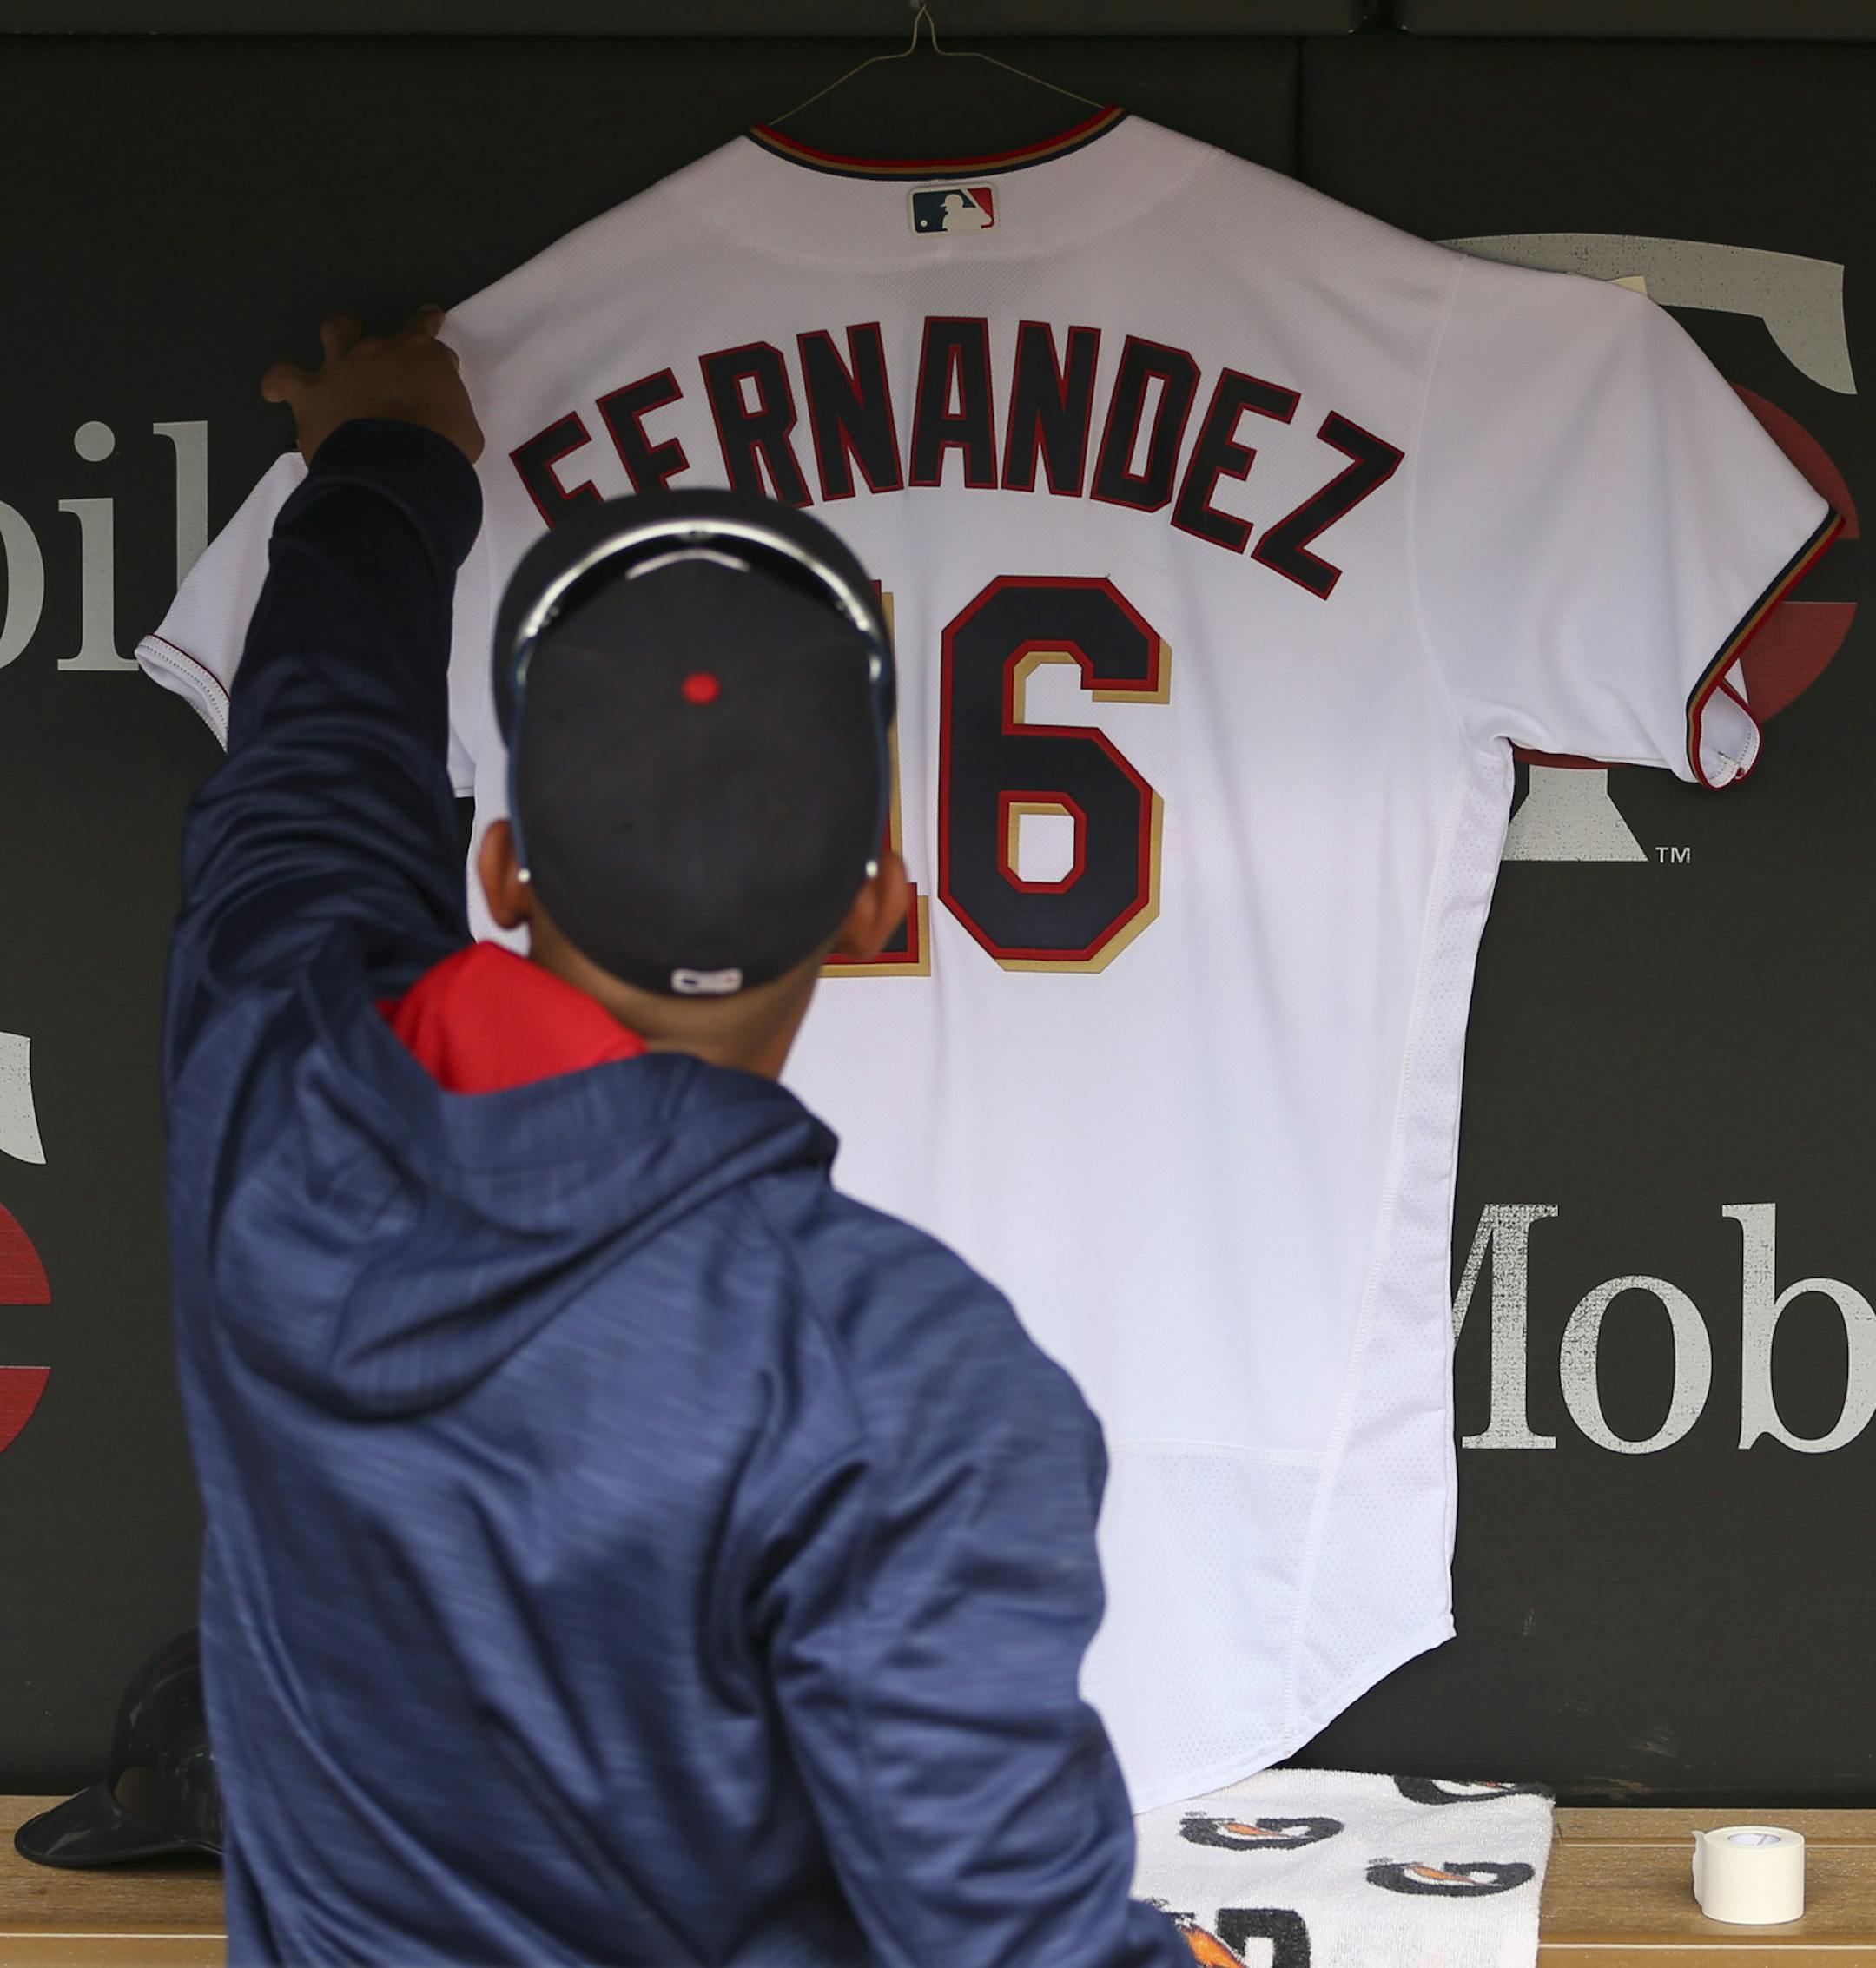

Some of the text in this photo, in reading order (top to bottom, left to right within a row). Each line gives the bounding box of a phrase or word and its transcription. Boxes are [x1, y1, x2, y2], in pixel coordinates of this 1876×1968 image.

[0, 420, 208, 671] il
[510, 315, 1405, 601] FERNANDEZ
[818, 574, 1172, 978] 6
[1655, 846, 1691, 864] TM
